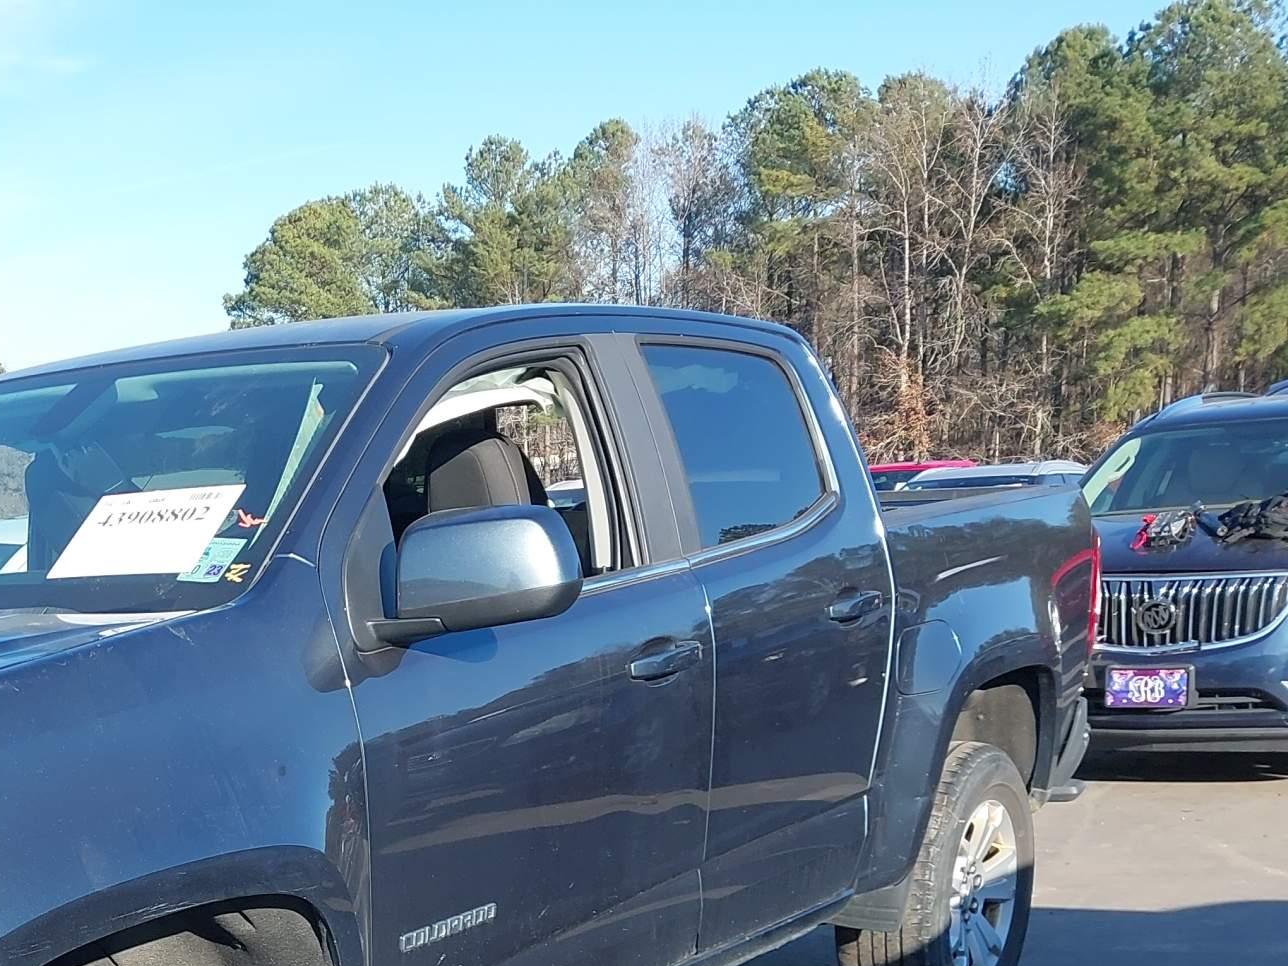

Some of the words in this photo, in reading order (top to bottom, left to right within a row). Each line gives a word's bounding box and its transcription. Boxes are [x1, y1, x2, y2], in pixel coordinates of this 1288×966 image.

[98, 505, 210, 527] 43908802
[205, 564, 223, 576] 23
[399, 902, 497, 952] COLORADO
